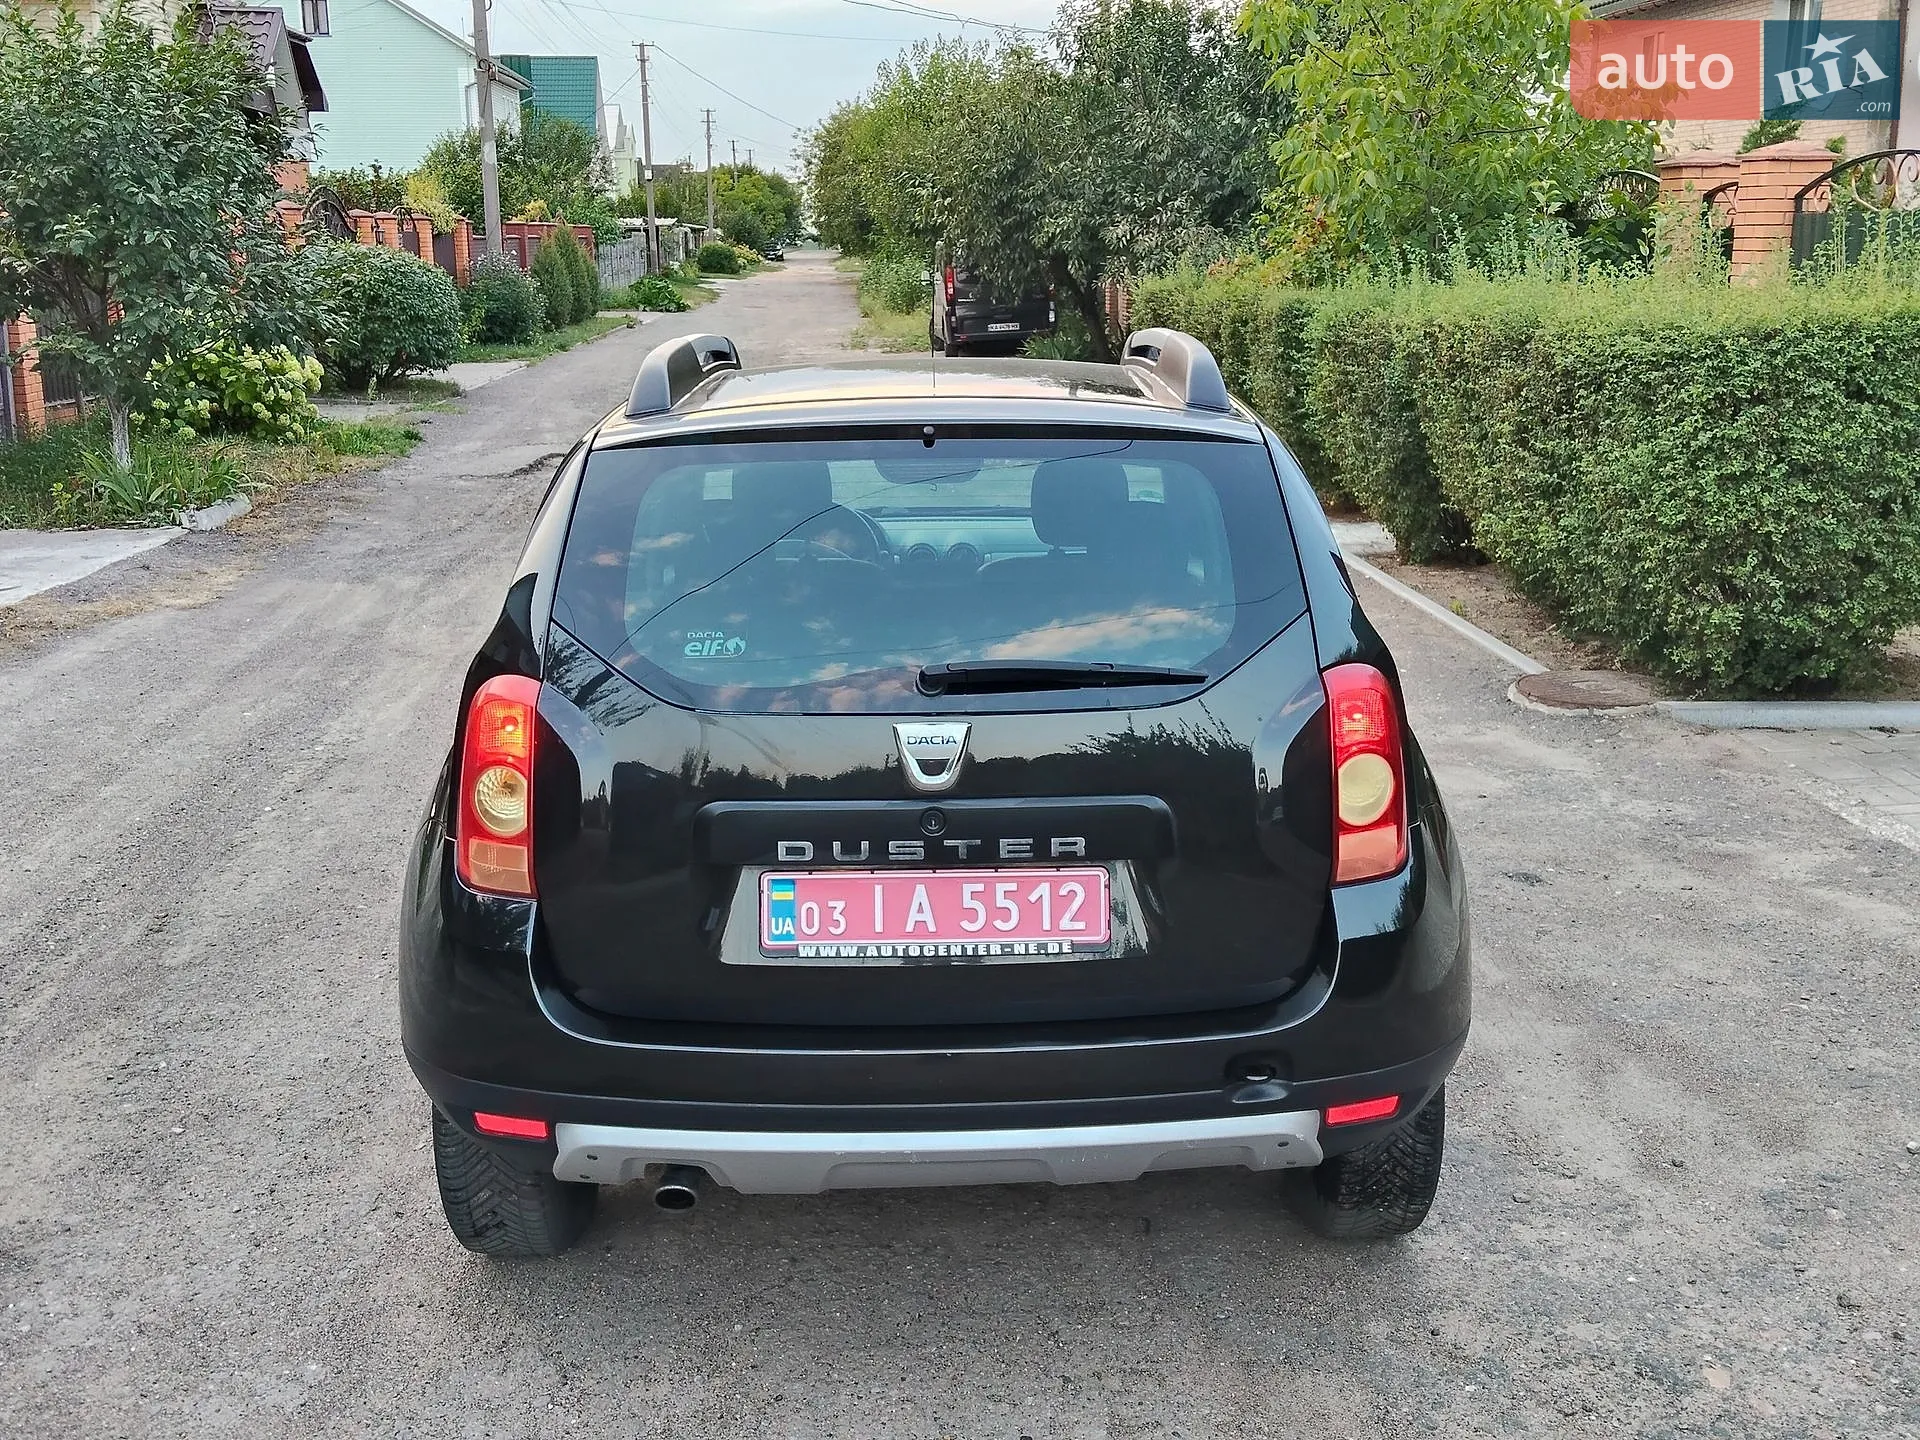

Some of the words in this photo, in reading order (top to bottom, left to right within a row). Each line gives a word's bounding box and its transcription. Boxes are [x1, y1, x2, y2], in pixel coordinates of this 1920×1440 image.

[687, 631, 724, 639] DACIA
[684, 639, 724, 656] elf
[907, 735, 957, 745] DACIA
[777, 836, 1087, 861] DUSTER
[800, 900, 847, 936] 03
[959, 881, 1087, 932] 5512
[771, 917, 795, 935] UA
[798, 942, 1073, 958] WWW.AUTOCENTER-NE.DE
